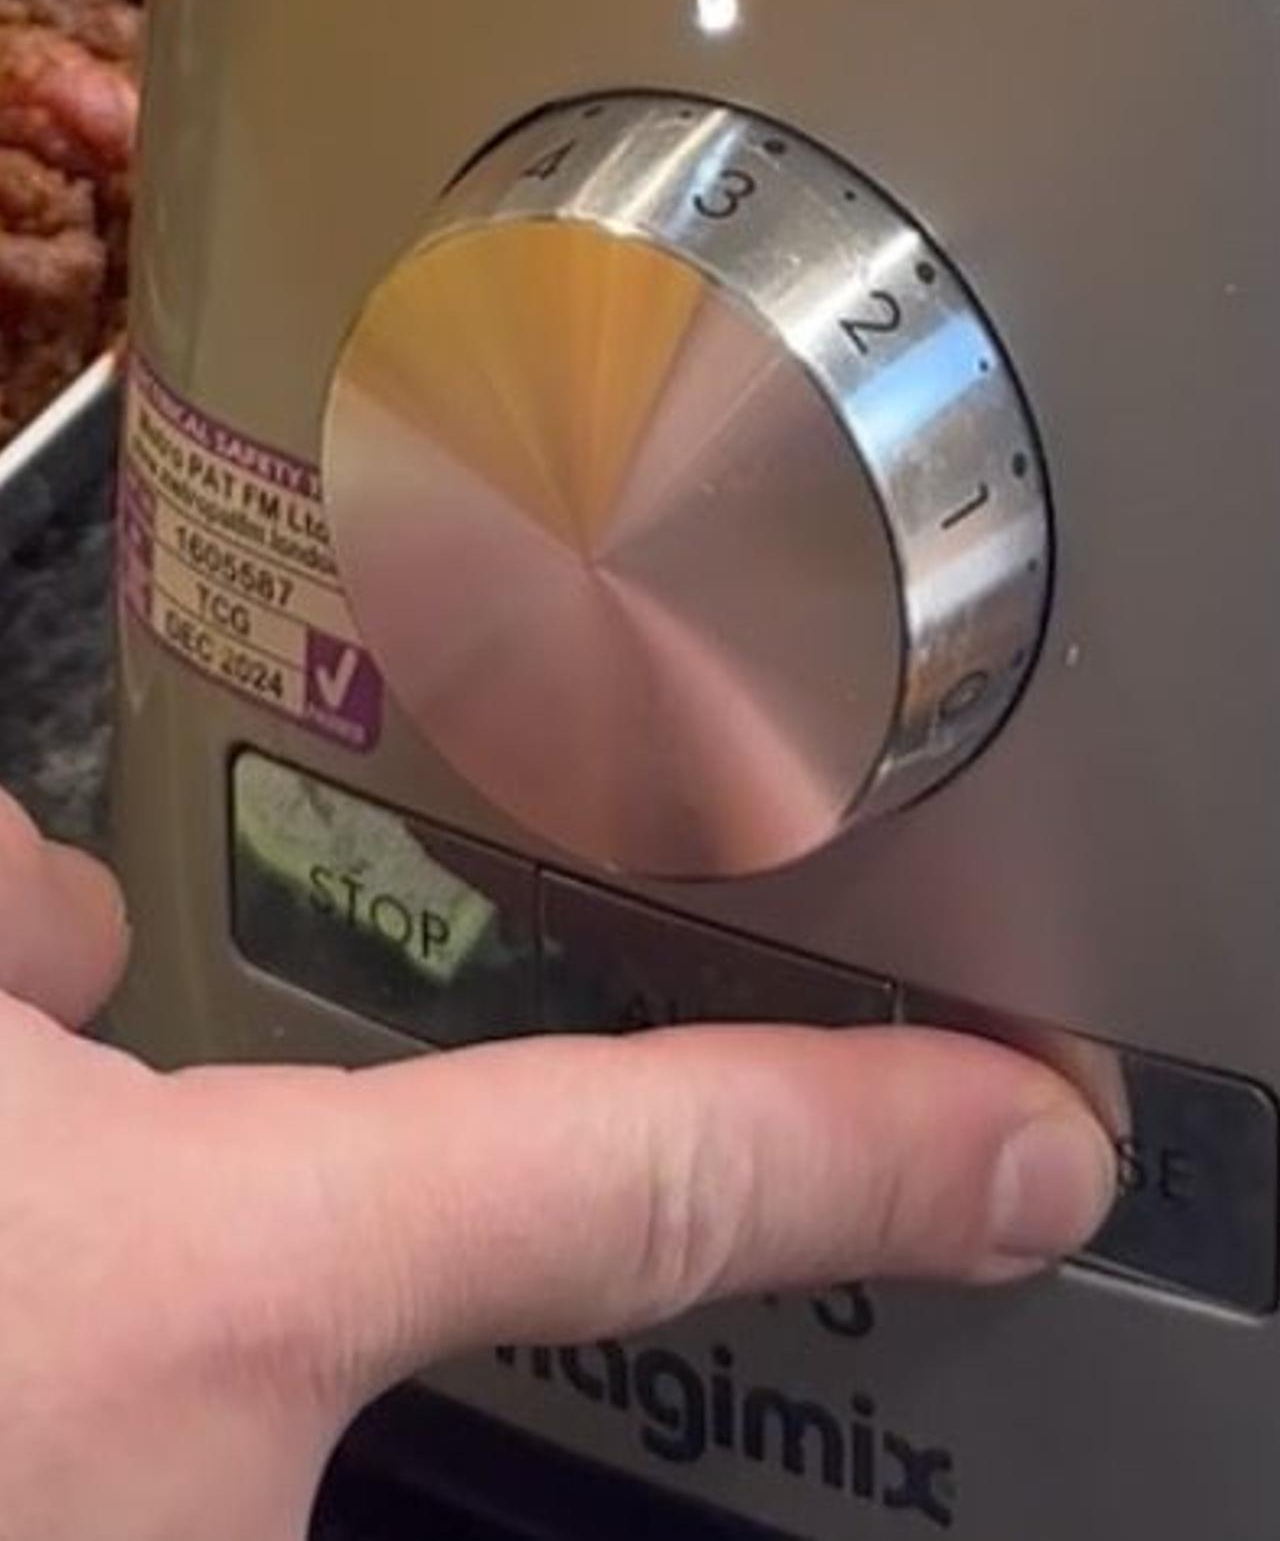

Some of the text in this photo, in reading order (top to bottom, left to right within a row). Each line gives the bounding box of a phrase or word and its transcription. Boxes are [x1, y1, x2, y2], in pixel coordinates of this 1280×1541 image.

[523, 138, 576, 182] 4
[692, 168, 757, 220] 3
[838, 289, 903, 356] 2
[939, 479, 990, 530] 1
[308, 864, 452, 960] STOP
